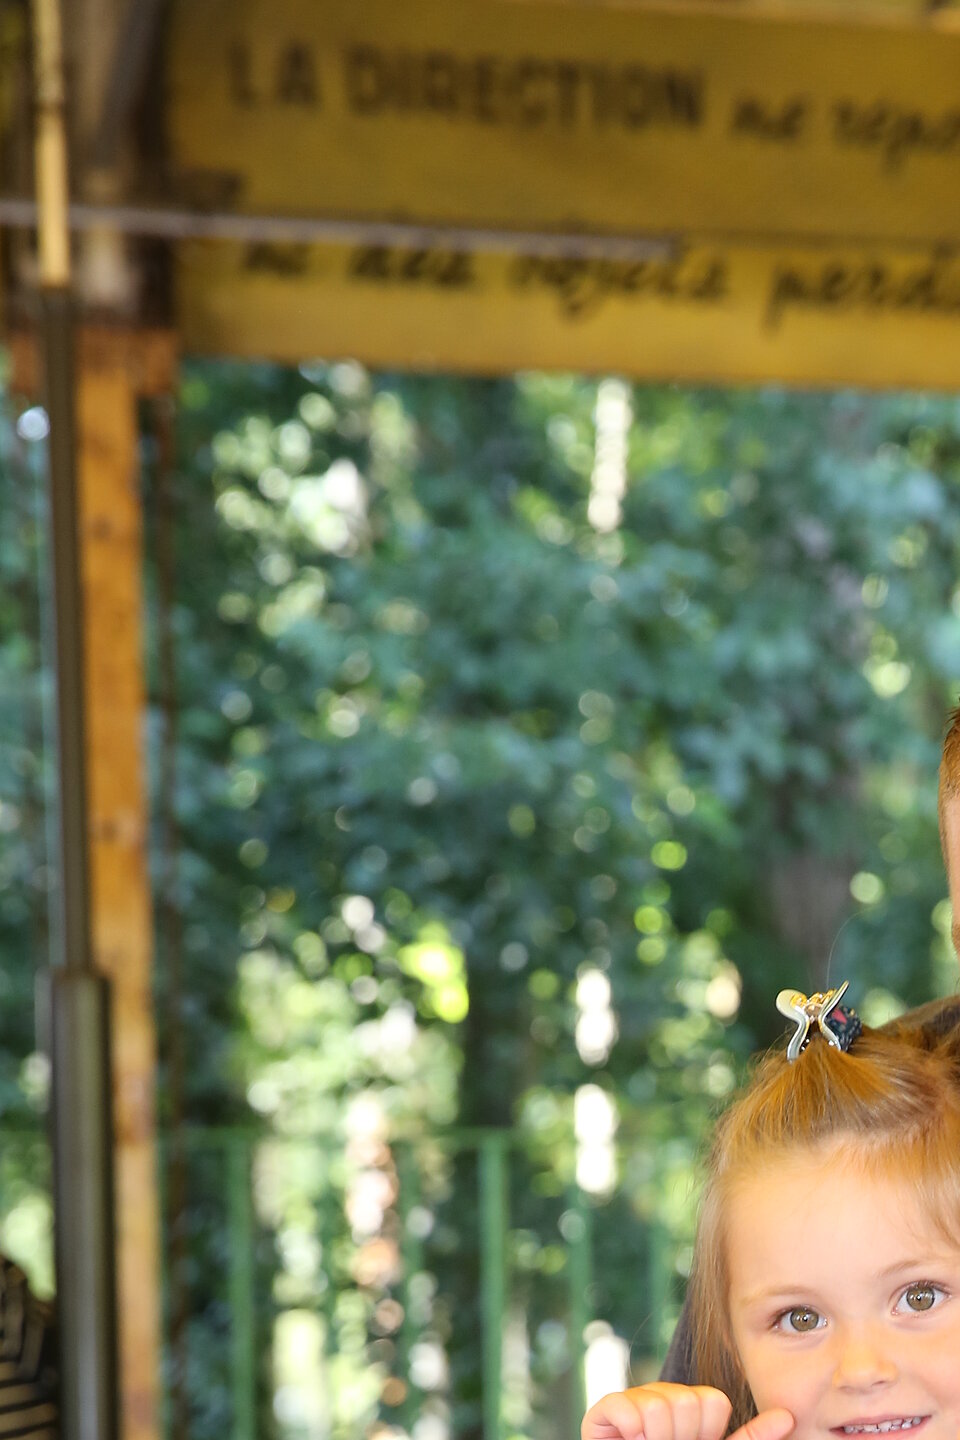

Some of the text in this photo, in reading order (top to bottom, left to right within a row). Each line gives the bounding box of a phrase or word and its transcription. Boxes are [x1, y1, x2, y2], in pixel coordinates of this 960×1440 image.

[226, 40, 320, 112] LA
[345, 45, 704, 127] DIRECTION
[733, 92, 808, 142] ne
